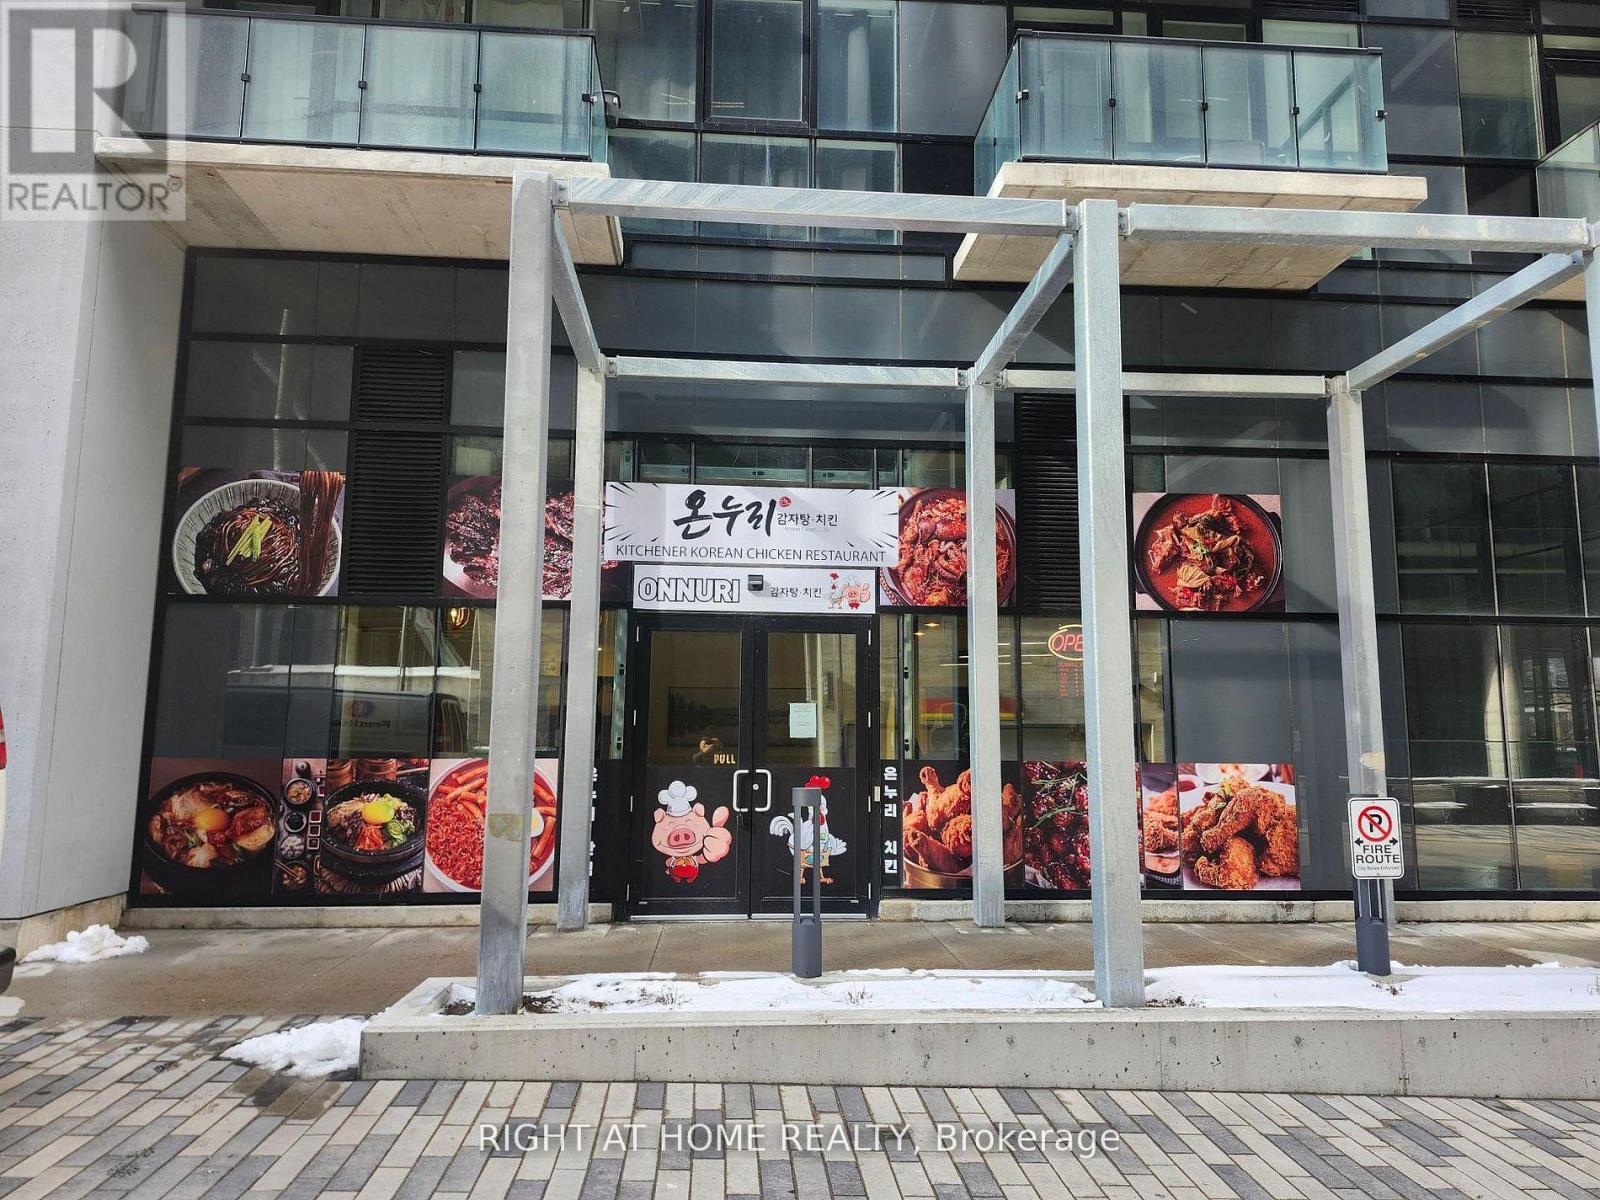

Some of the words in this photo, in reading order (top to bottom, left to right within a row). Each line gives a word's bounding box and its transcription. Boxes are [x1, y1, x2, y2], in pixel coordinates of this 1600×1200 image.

[672, 489, 777, 540] 온누리
[616, 544, 687, 558] KITCHENER
[691, 546, 743, 559] KOREAN
[746, 547, 802, 560] CHICKEN
[806, 550, 886, 563] RESTAURANT
[638, 577, 741, 603] ONNURI
[1051, 633, 1084, 652] OPE
[713, 753, 736, 764] PULL
[883, 840, 898, 874] 치킨
[1362, 844, 1392, 854] FIRE
[1355, 854, 1401, 864] ROUTE
